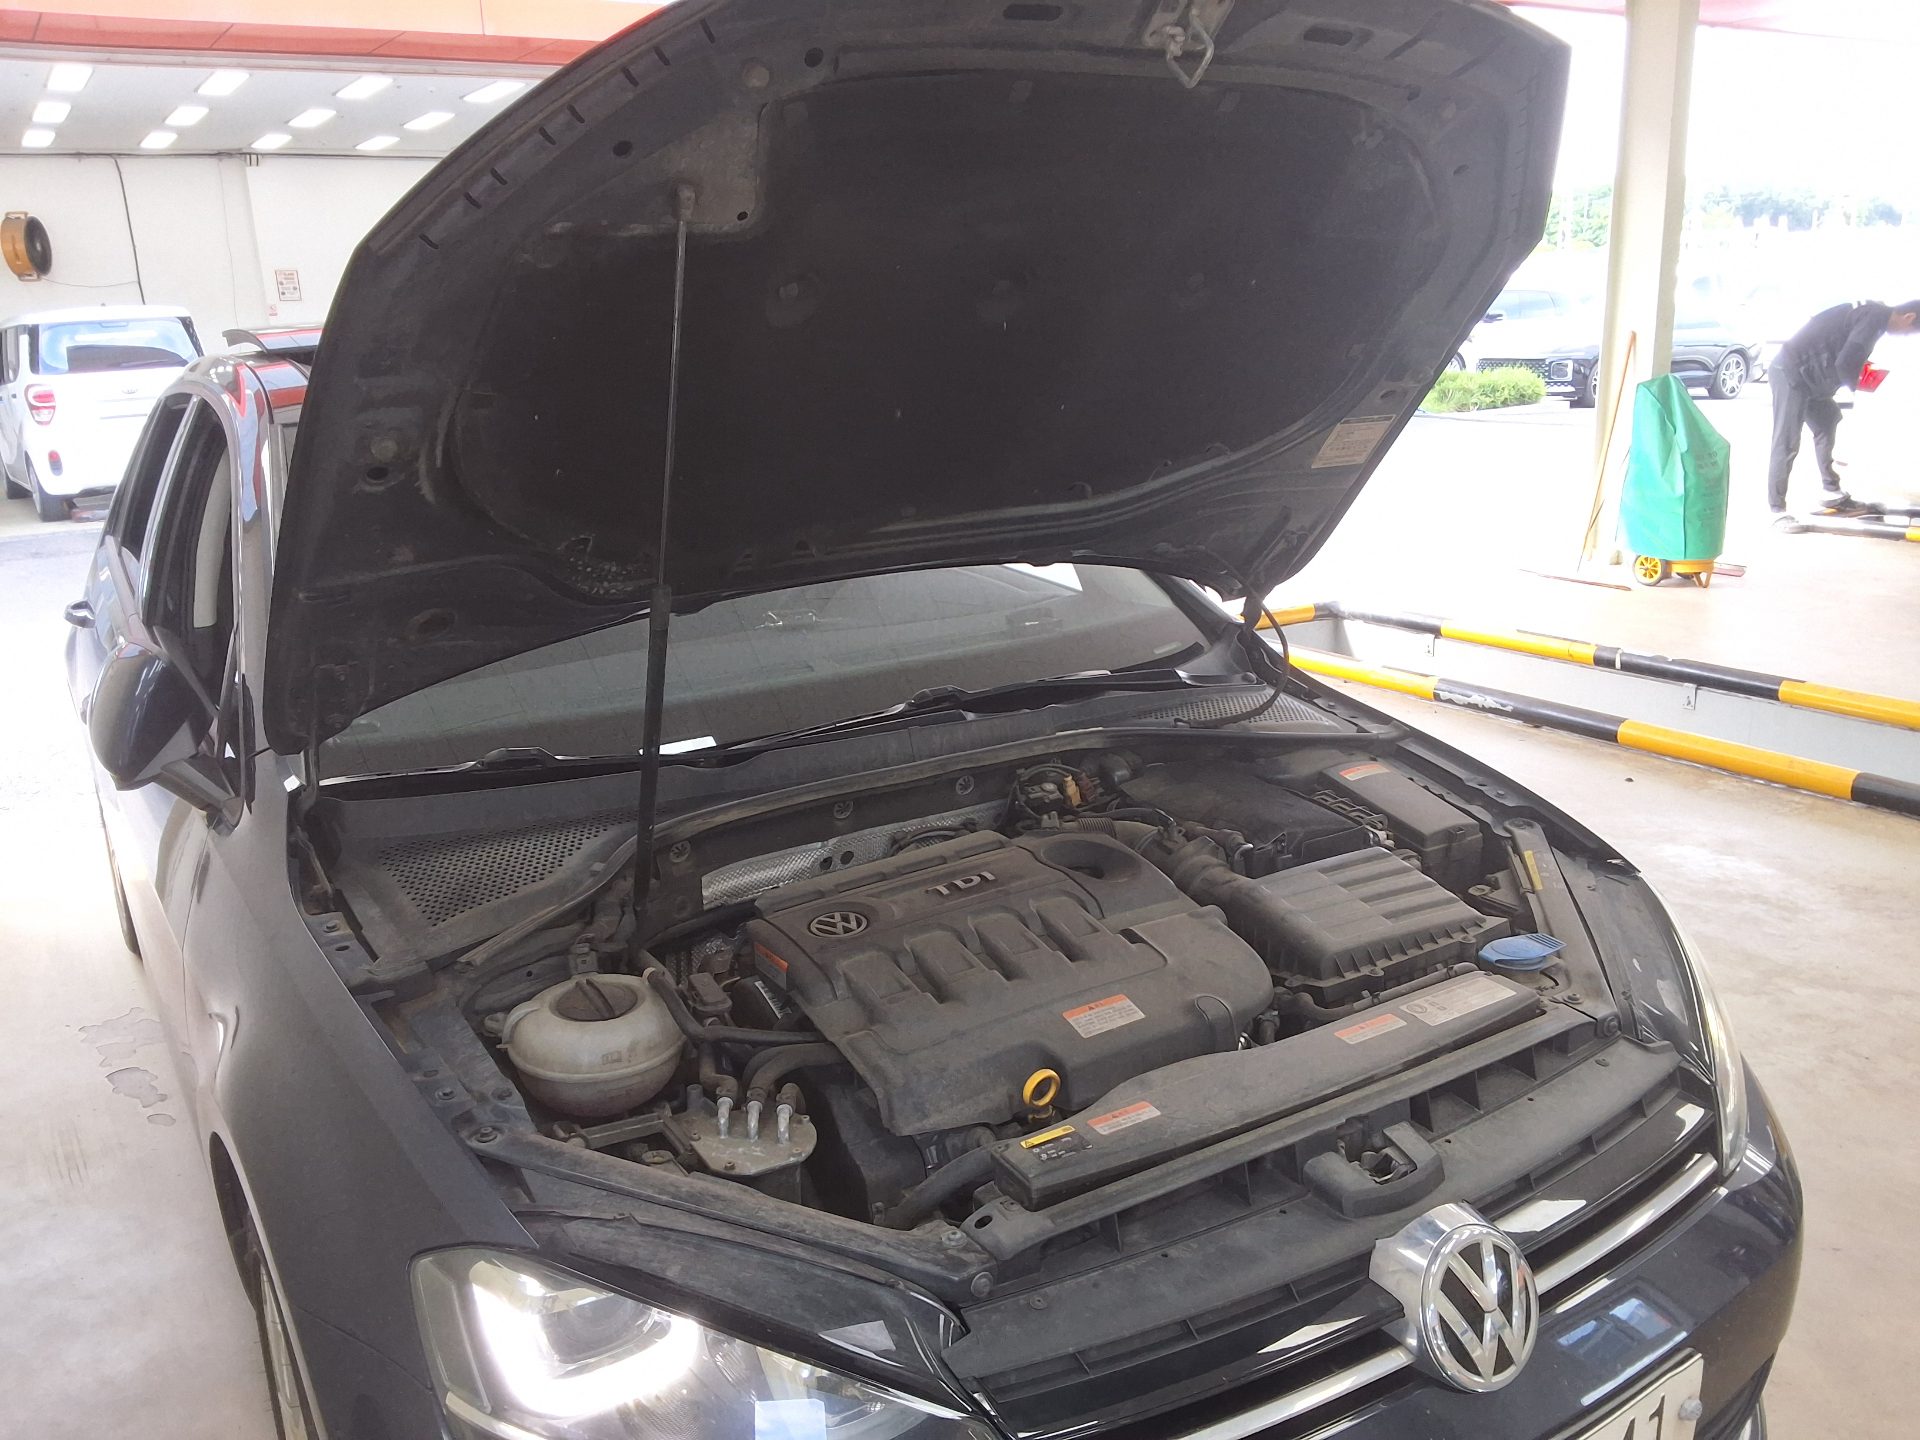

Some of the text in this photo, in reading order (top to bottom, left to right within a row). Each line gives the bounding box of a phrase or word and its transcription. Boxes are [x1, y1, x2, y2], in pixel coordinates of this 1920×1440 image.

[926, 871, 996, 896] TDI
[808, 911, 869, 938] VW
[1425, 1229, 1538, 1388] VW
